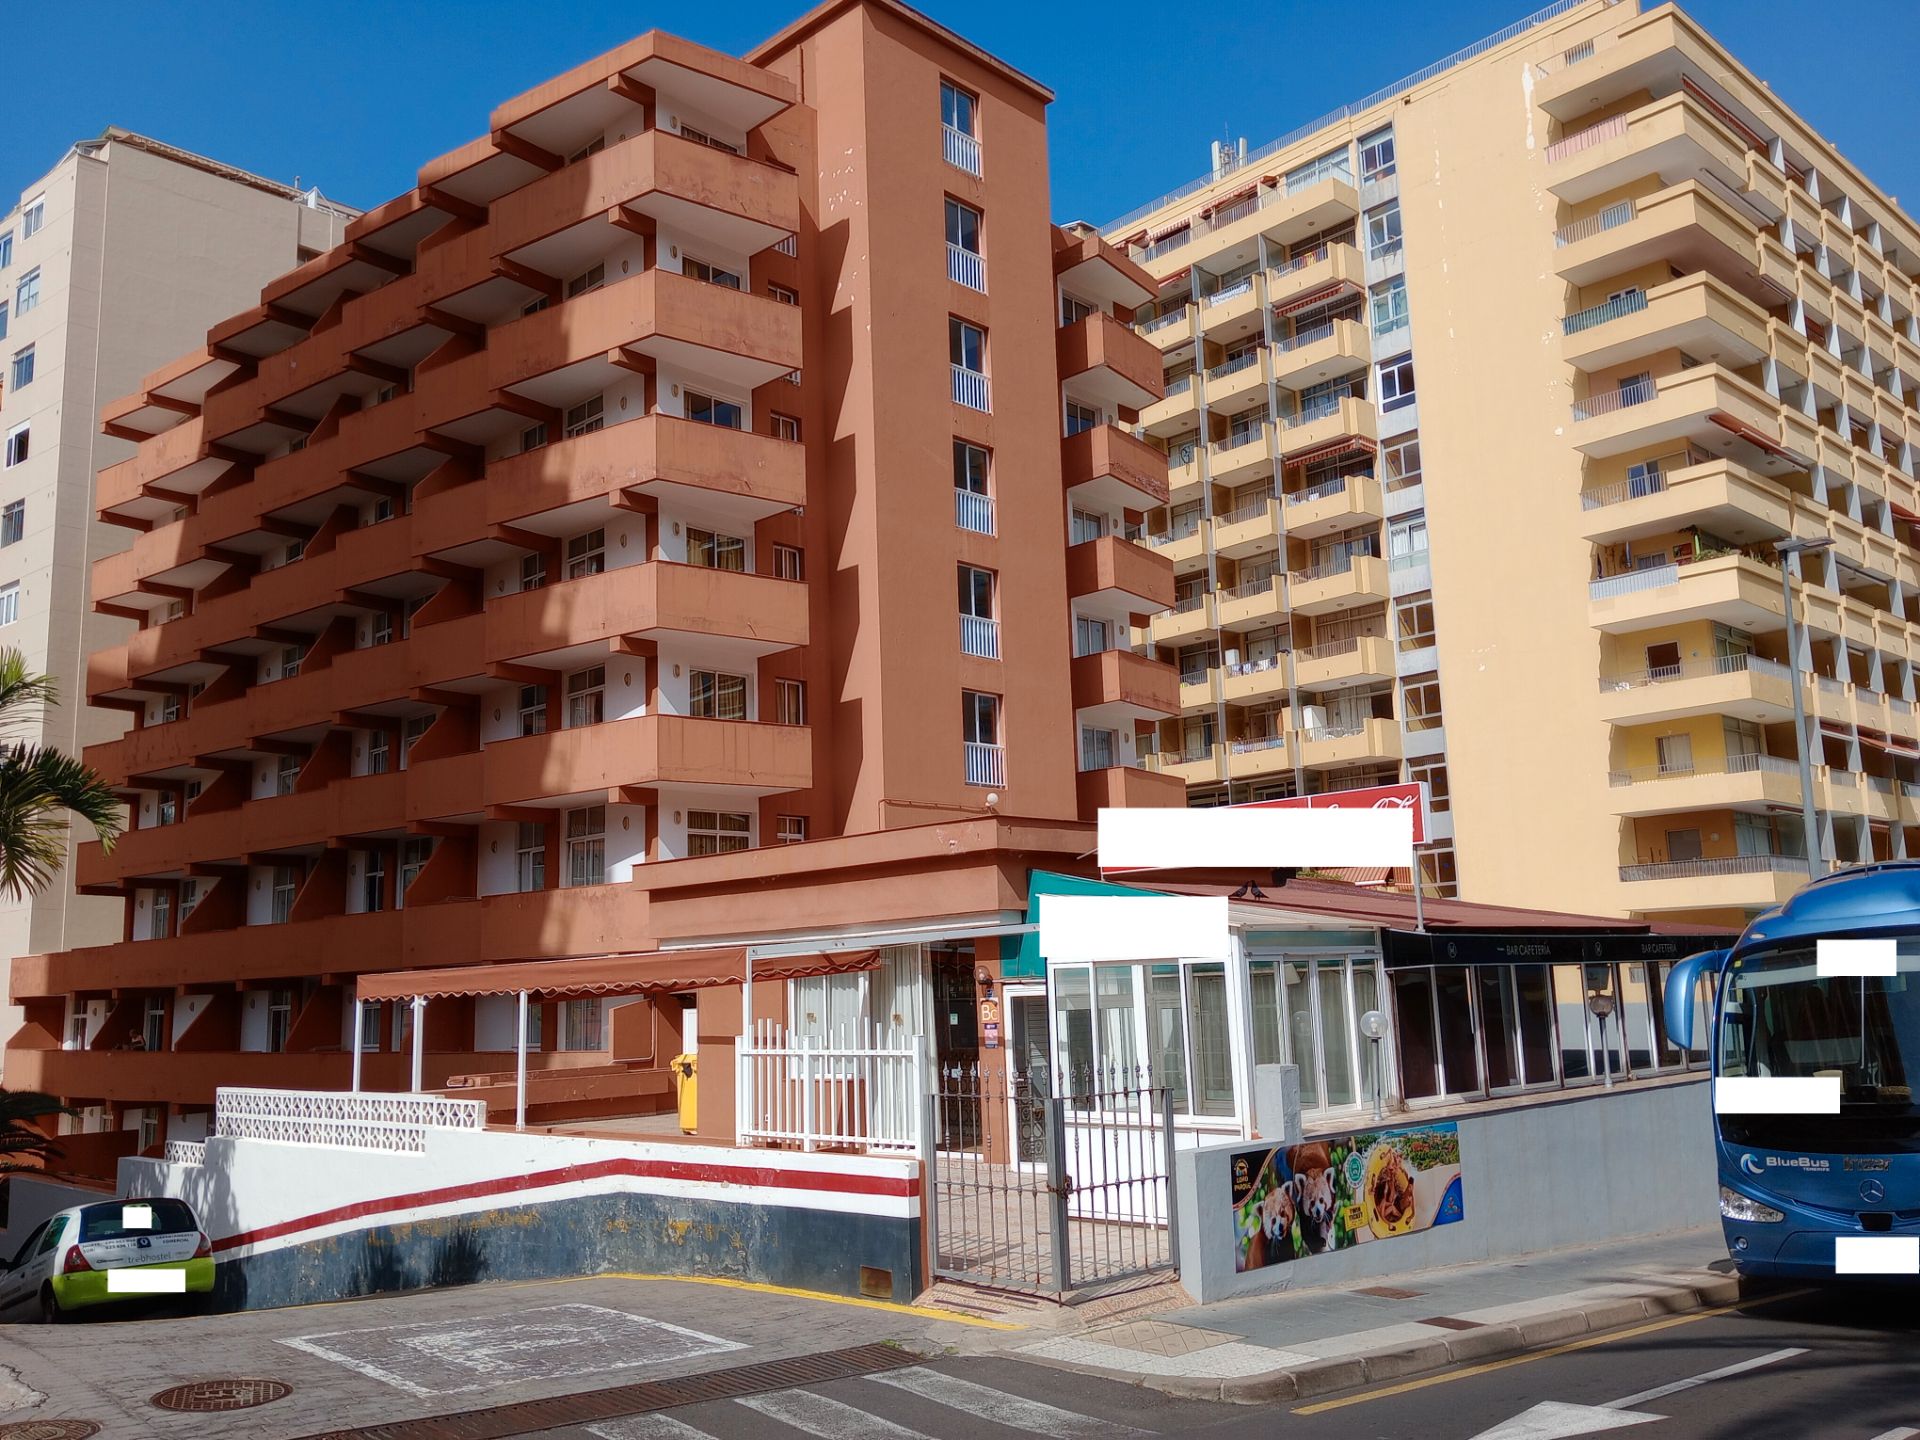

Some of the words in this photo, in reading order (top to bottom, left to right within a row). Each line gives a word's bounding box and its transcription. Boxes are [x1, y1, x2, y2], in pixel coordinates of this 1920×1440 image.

[1506, 944, 1519, 956] BAR
[1641, 943, 1651, 953] BAR
[1766, 1156, 1830, 1167] BlueBus
[1236, 1176, 1249, 1184] LORO
[127, 1252, 171, 1264] trebhostel
